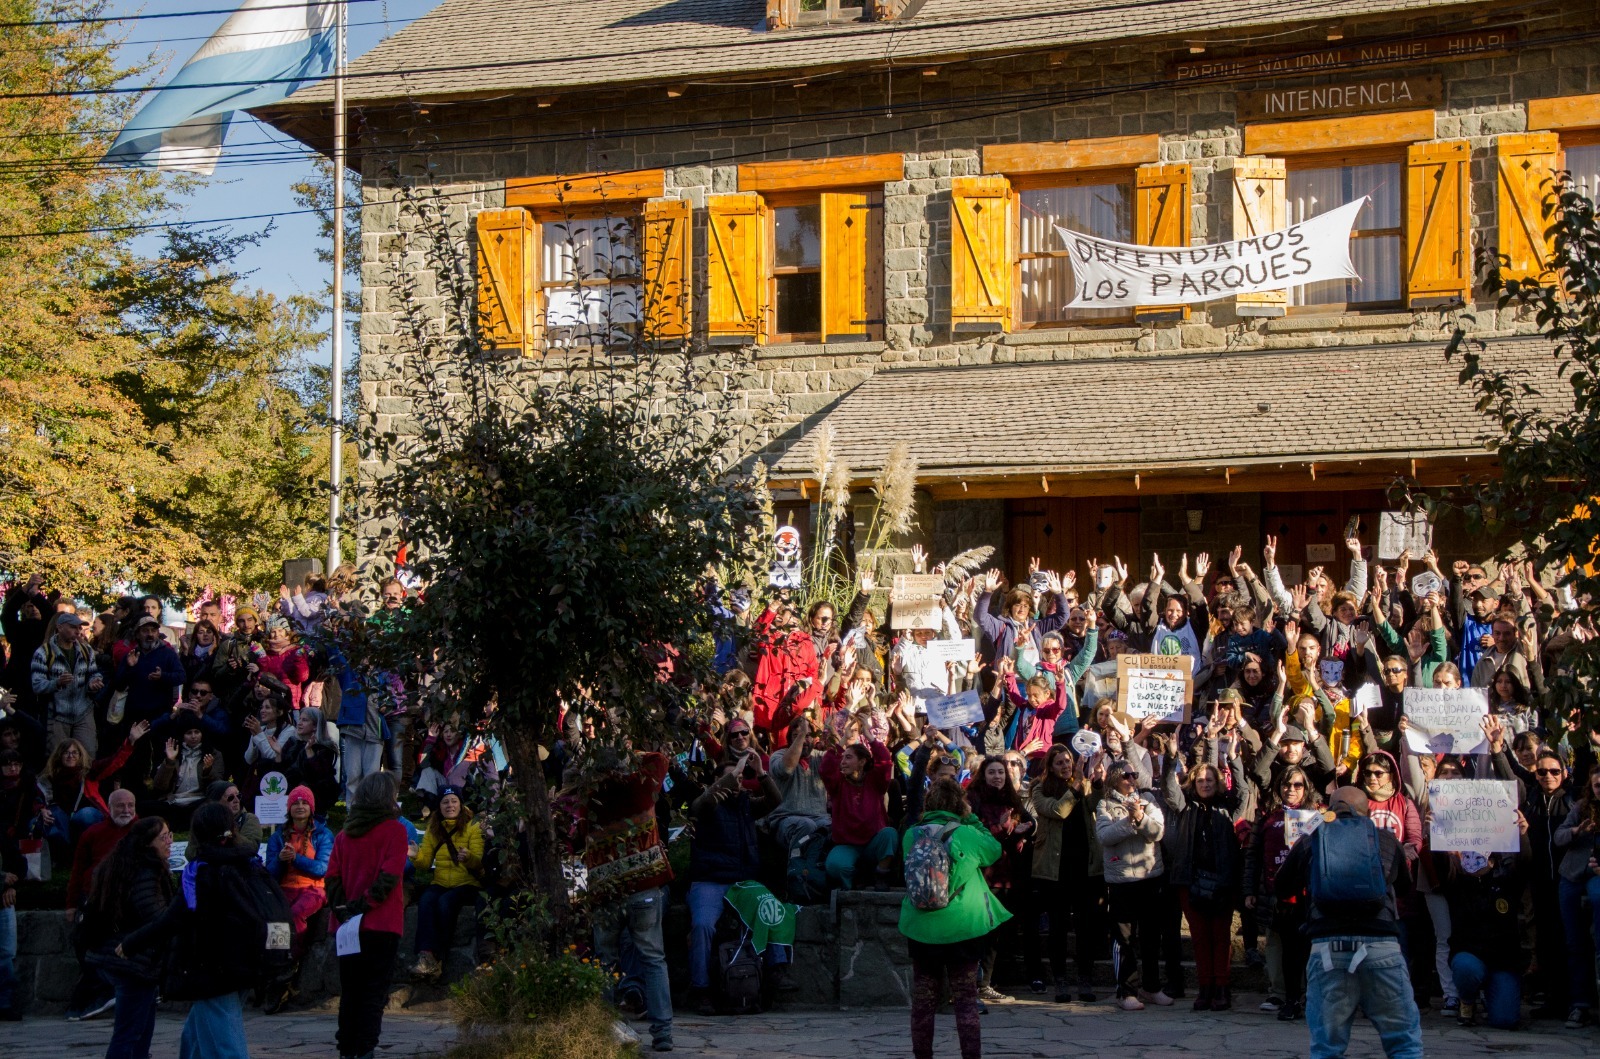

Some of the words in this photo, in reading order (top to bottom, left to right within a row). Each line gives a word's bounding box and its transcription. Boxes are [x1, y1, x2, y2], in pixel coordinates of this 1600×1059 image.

[1177, 63, 1246, 80] PARQUE
[1259, 51, 1348, 74] NACIONAL
[1361, 43, 1428, 64] NAHUEL
[1449, 34, 1505, 54] HUAPI
[1265, 81, 1412, 113] INTENDENCIA
[1075, 225, 1304, 268] DEFENDAMOS
[1082, 279, 1129, 302] LOS
[1152, 246, 1312, 297] PARQUES
[1124, 656, 1179, 665] CUIDEMOS
[1133, 681, 1175, 691] CUIDEMOS
[1465, 795, 1493, 811] gasto
[1496, 798, 1508, 808] es
